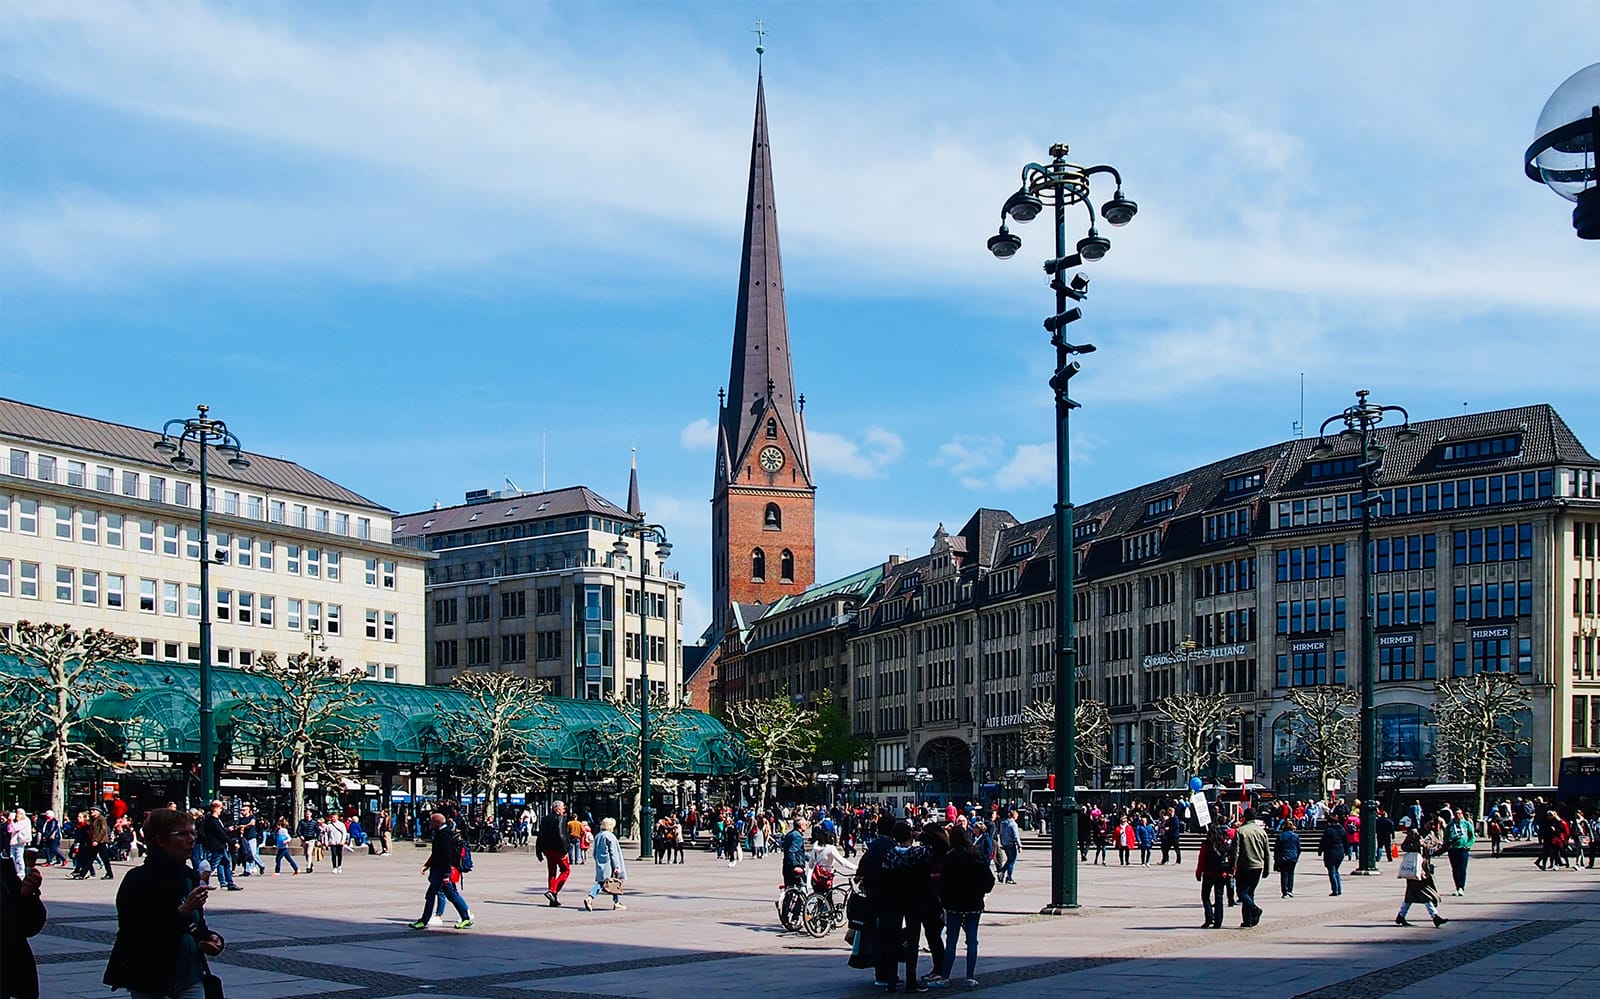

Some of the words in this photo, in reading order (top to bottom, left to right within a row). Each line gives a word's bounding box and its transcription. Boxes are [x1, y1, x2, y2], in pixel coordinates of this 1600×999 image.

[1472, 629, 1509, 639] HIRMER
[1379, 635, 1414, 645] HIRMER
[1210, 645, 1246, 658] ALLIANZ
[1292, 642, 1325, 652] HIRMER
[986, 717, 999, 728] ALTE
